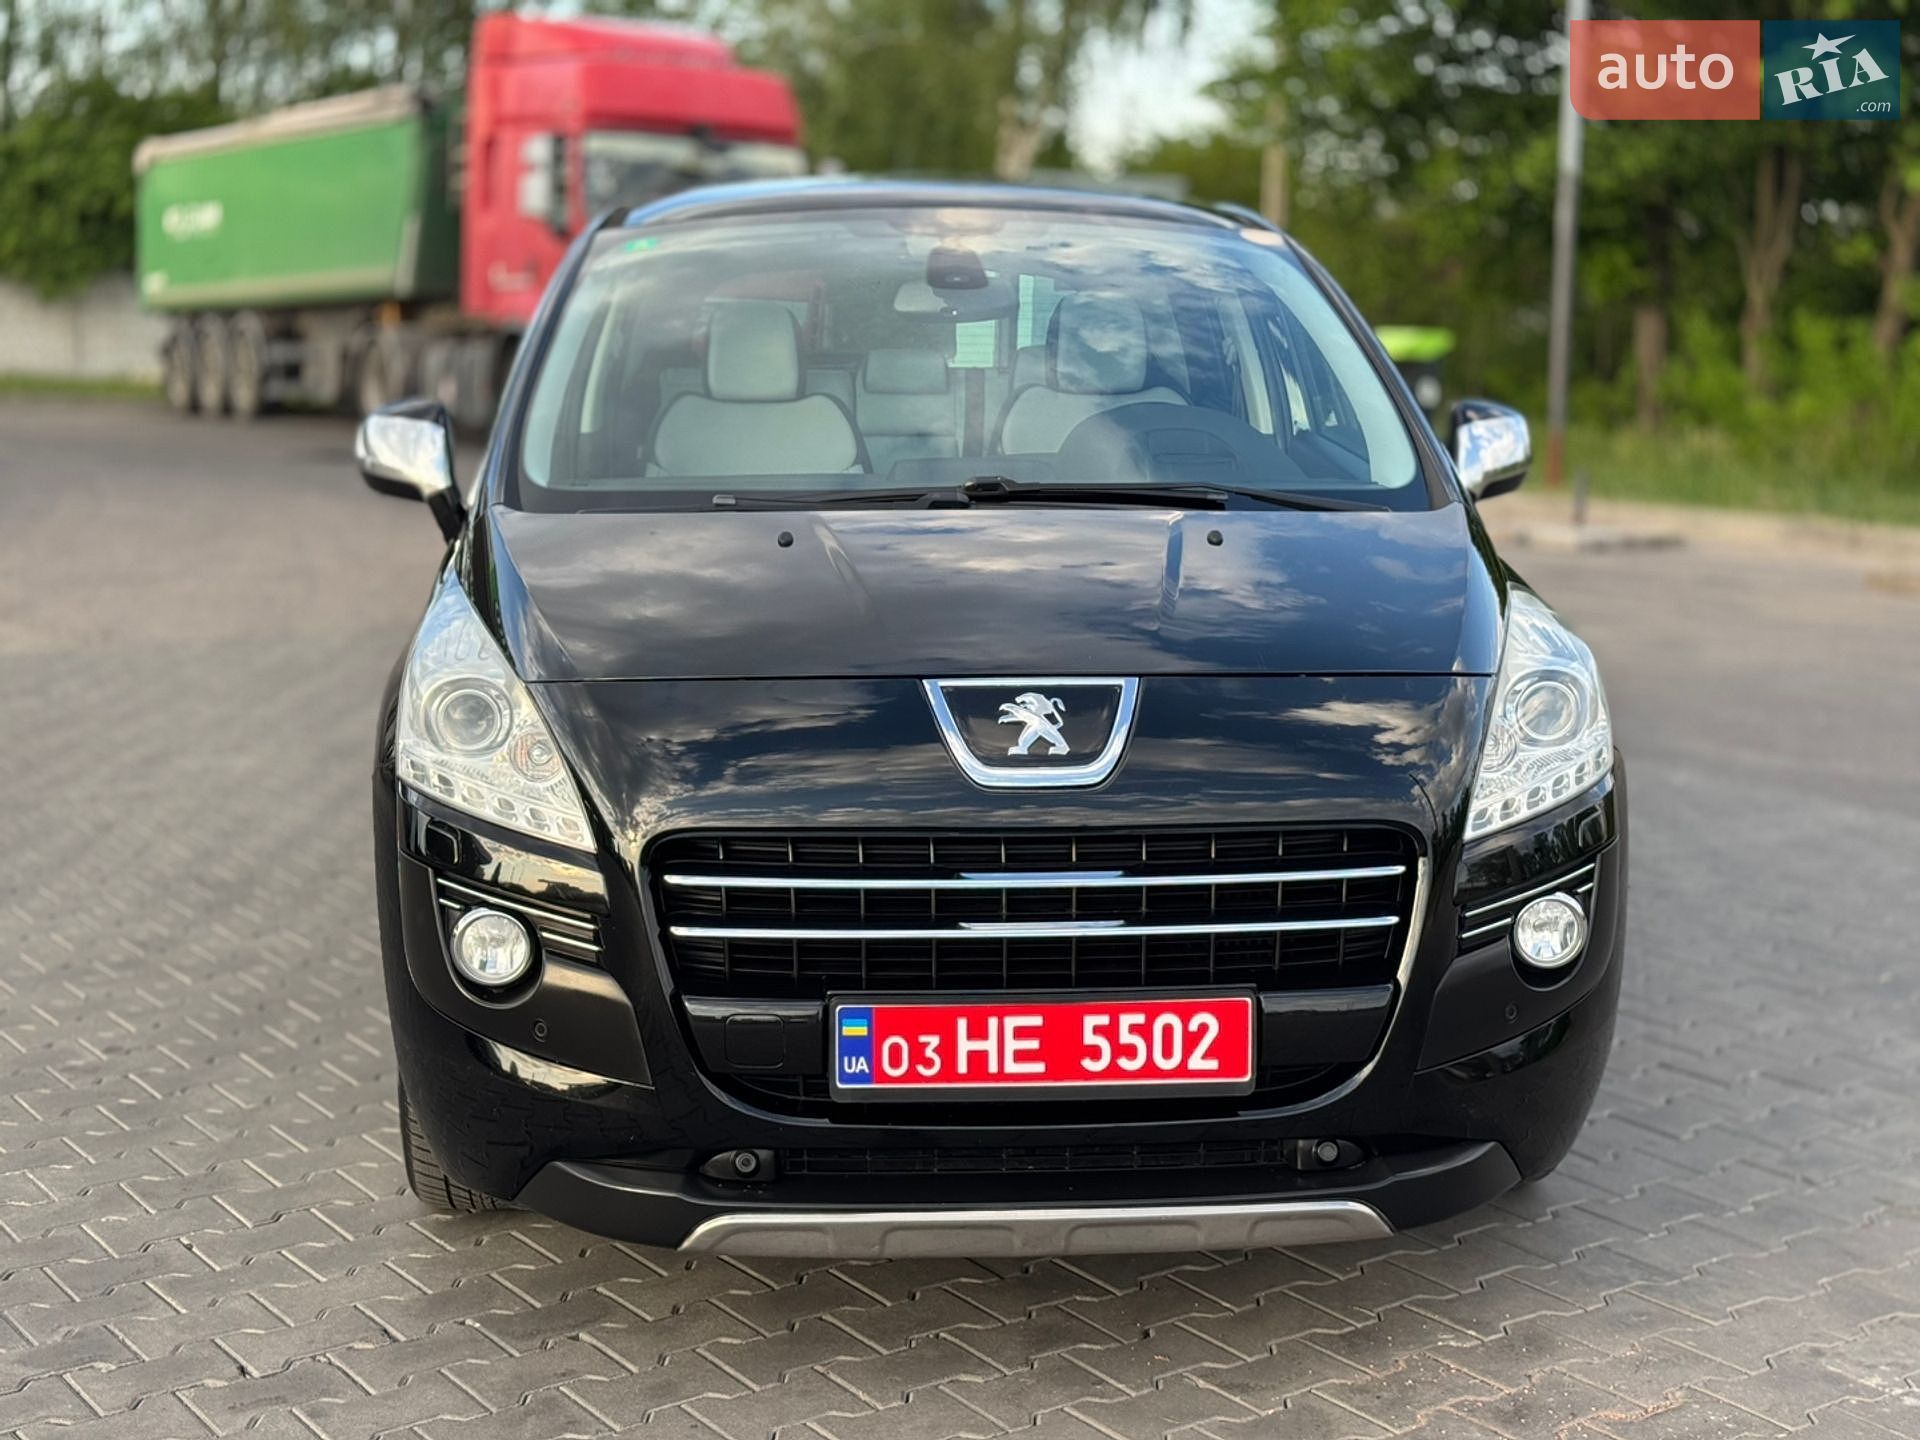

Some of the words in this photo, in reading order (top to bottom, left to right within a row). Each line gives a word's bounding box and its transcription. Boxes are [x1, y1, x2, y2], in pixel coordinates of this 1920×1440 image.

[843, 1056, 869, 1074] UA
[881, 1034, 942, 1077] 03
[956, 1014, 1046, 1075] HE
[1080, 1012, 1220, 1073] 5502
